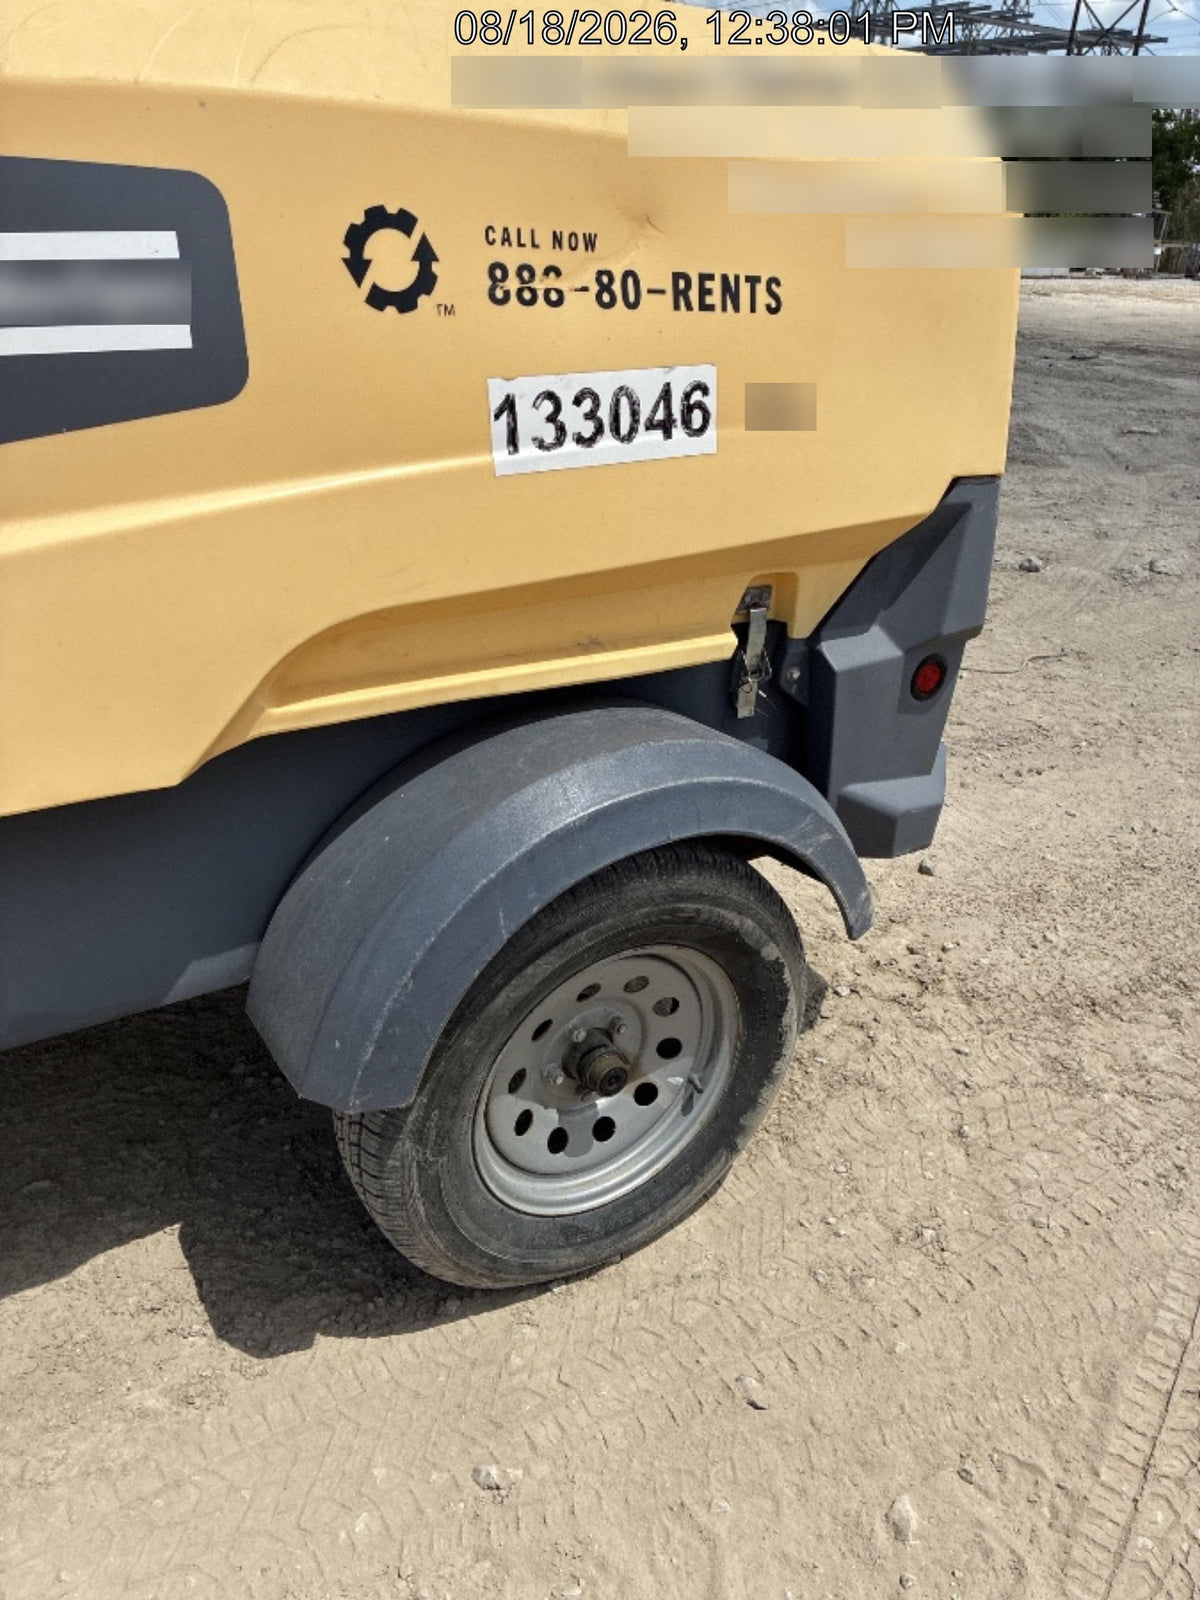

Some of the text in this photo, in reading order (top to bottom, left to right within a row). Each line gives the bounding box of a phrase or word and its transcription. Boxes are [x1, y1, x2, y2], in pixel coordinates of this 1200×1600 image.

[484, 225, 598, 253] CALL NOW
[437, 303, 456, 317] TM
[493, 381, 711, 456] 133046
